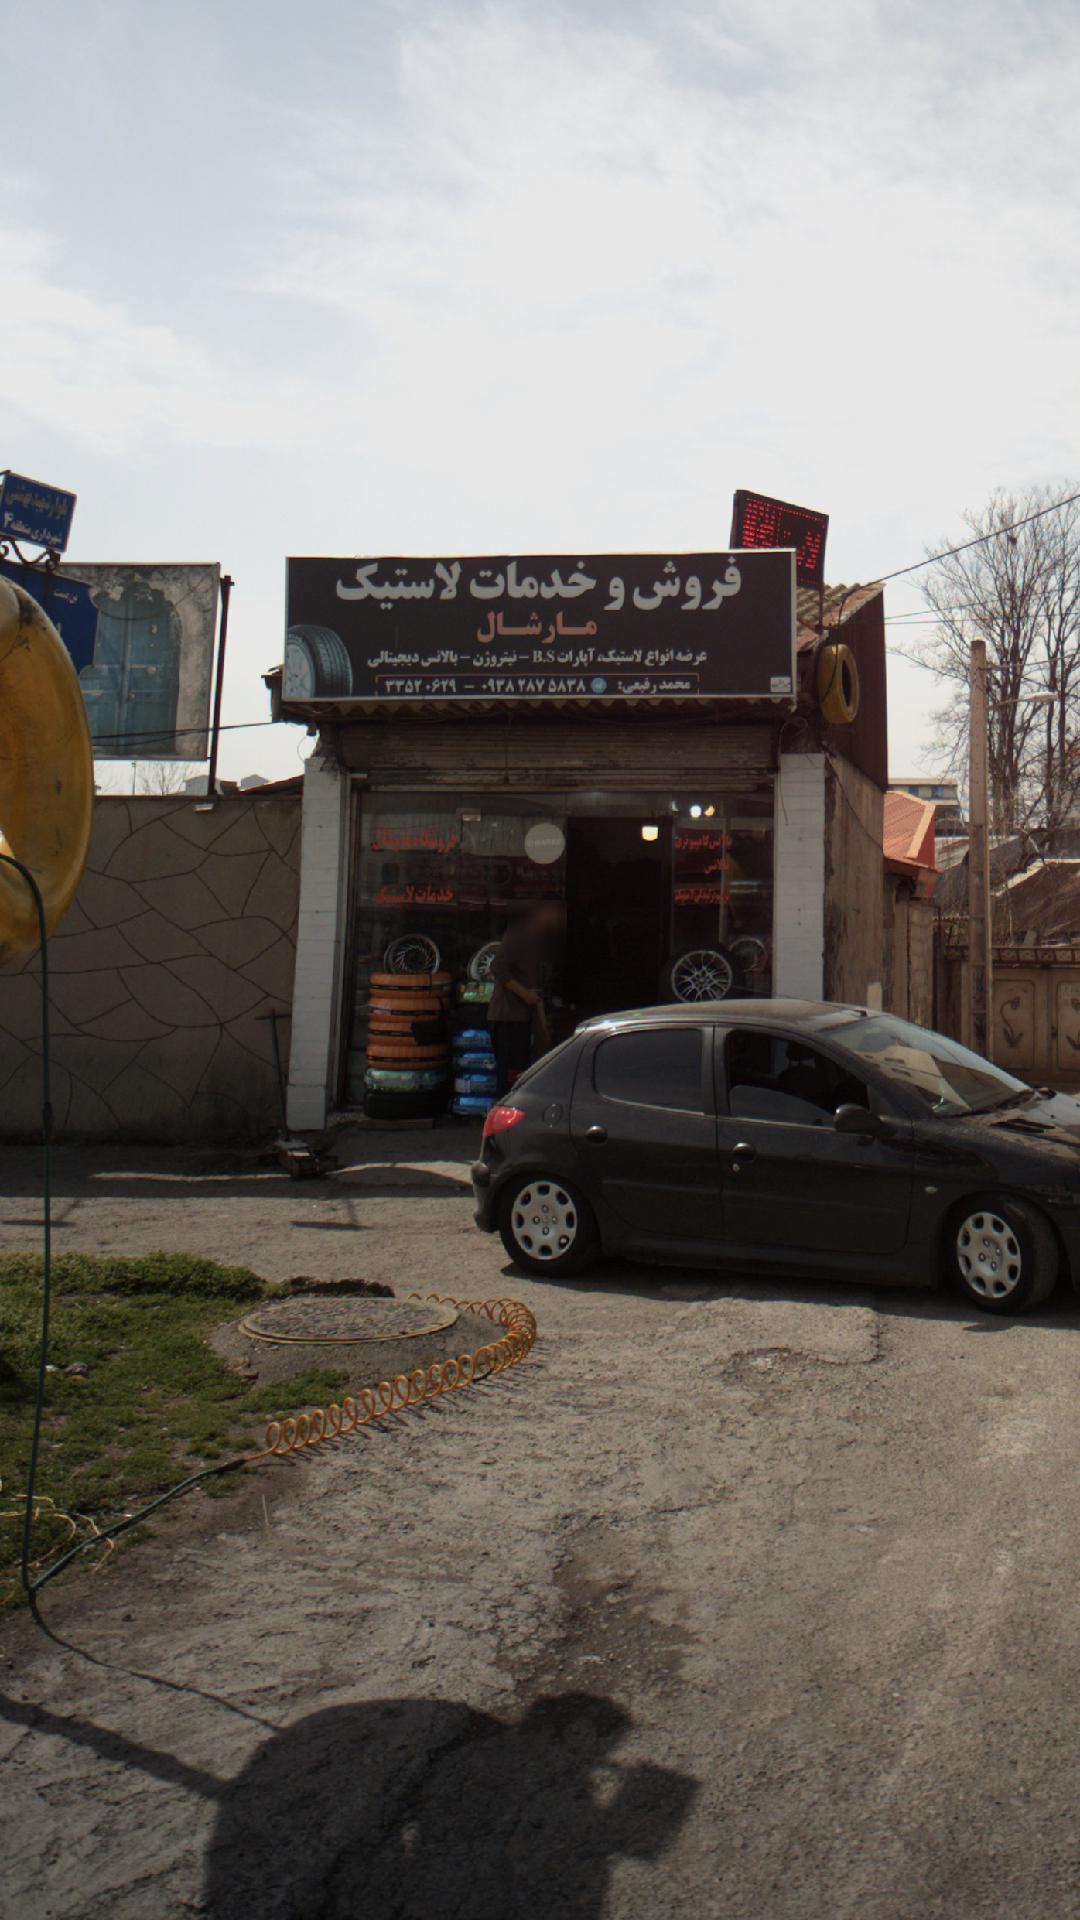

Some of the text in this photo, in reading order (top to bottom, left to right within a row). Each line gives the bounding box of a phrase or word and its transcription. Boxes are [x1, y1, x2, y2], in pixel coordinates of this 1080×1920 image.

[31, 528, 62, 545] شهرداری
[336, 556, 742, 610] فروش و خدمات لاستیک
[476, 610, 597, 643] مارشال
[367, 650, 420, 668] دیجیتالی
[421, 650, 458, 667] بالانس
[472, 650, 517, 668] نیتروژن
[557, 647, 595, 668] آپارات
[644, 648, 674, 666] انواع
[675, 650, 707, 666] عرضه
[659, 677, 691, 689] محمد
